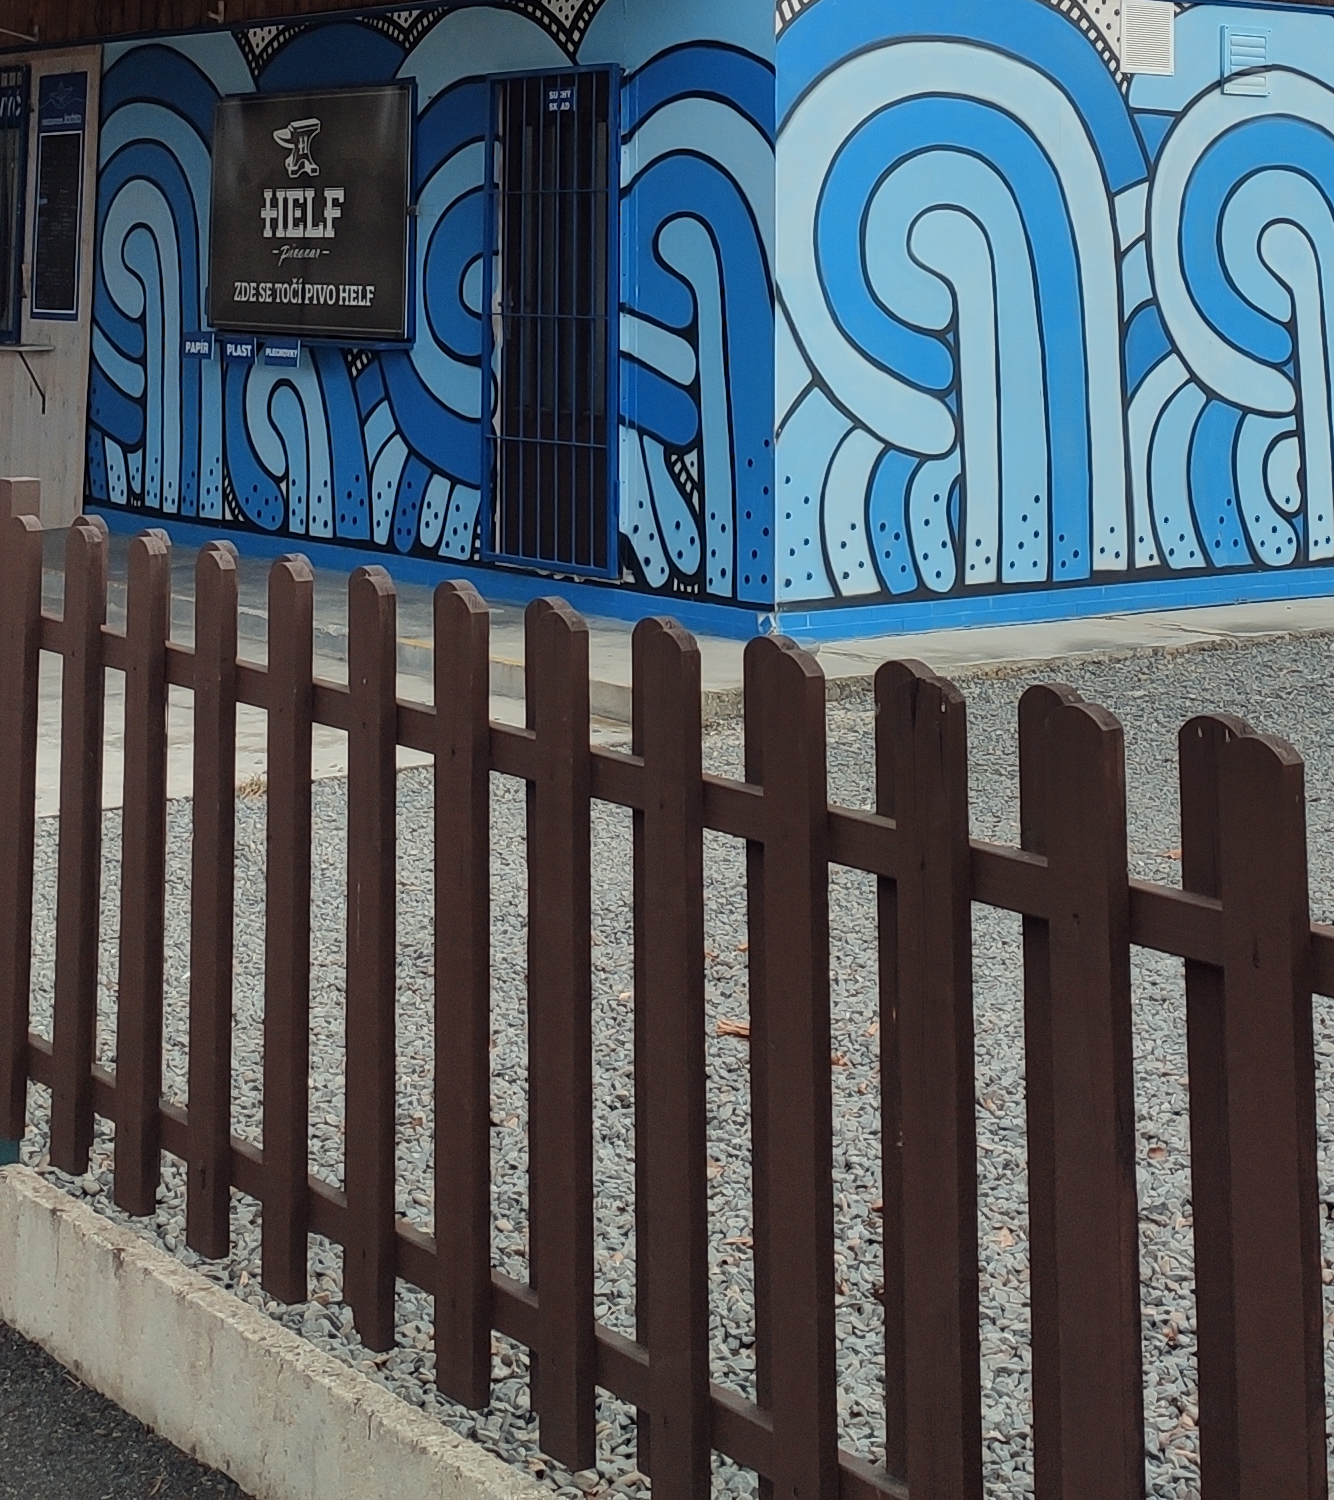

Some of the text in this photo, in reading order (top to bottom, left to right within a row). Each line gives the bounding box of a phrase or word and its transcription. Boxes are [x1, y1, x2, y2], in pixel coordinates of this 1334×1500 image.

[260, 186, 346, 239] HELF
[233, 277, 376, 307] ZDE SE TOČÍ PIVO HELF
[185, 338, 209, 355] PAPÍR
[226, 343, 252, 358] PLAST
